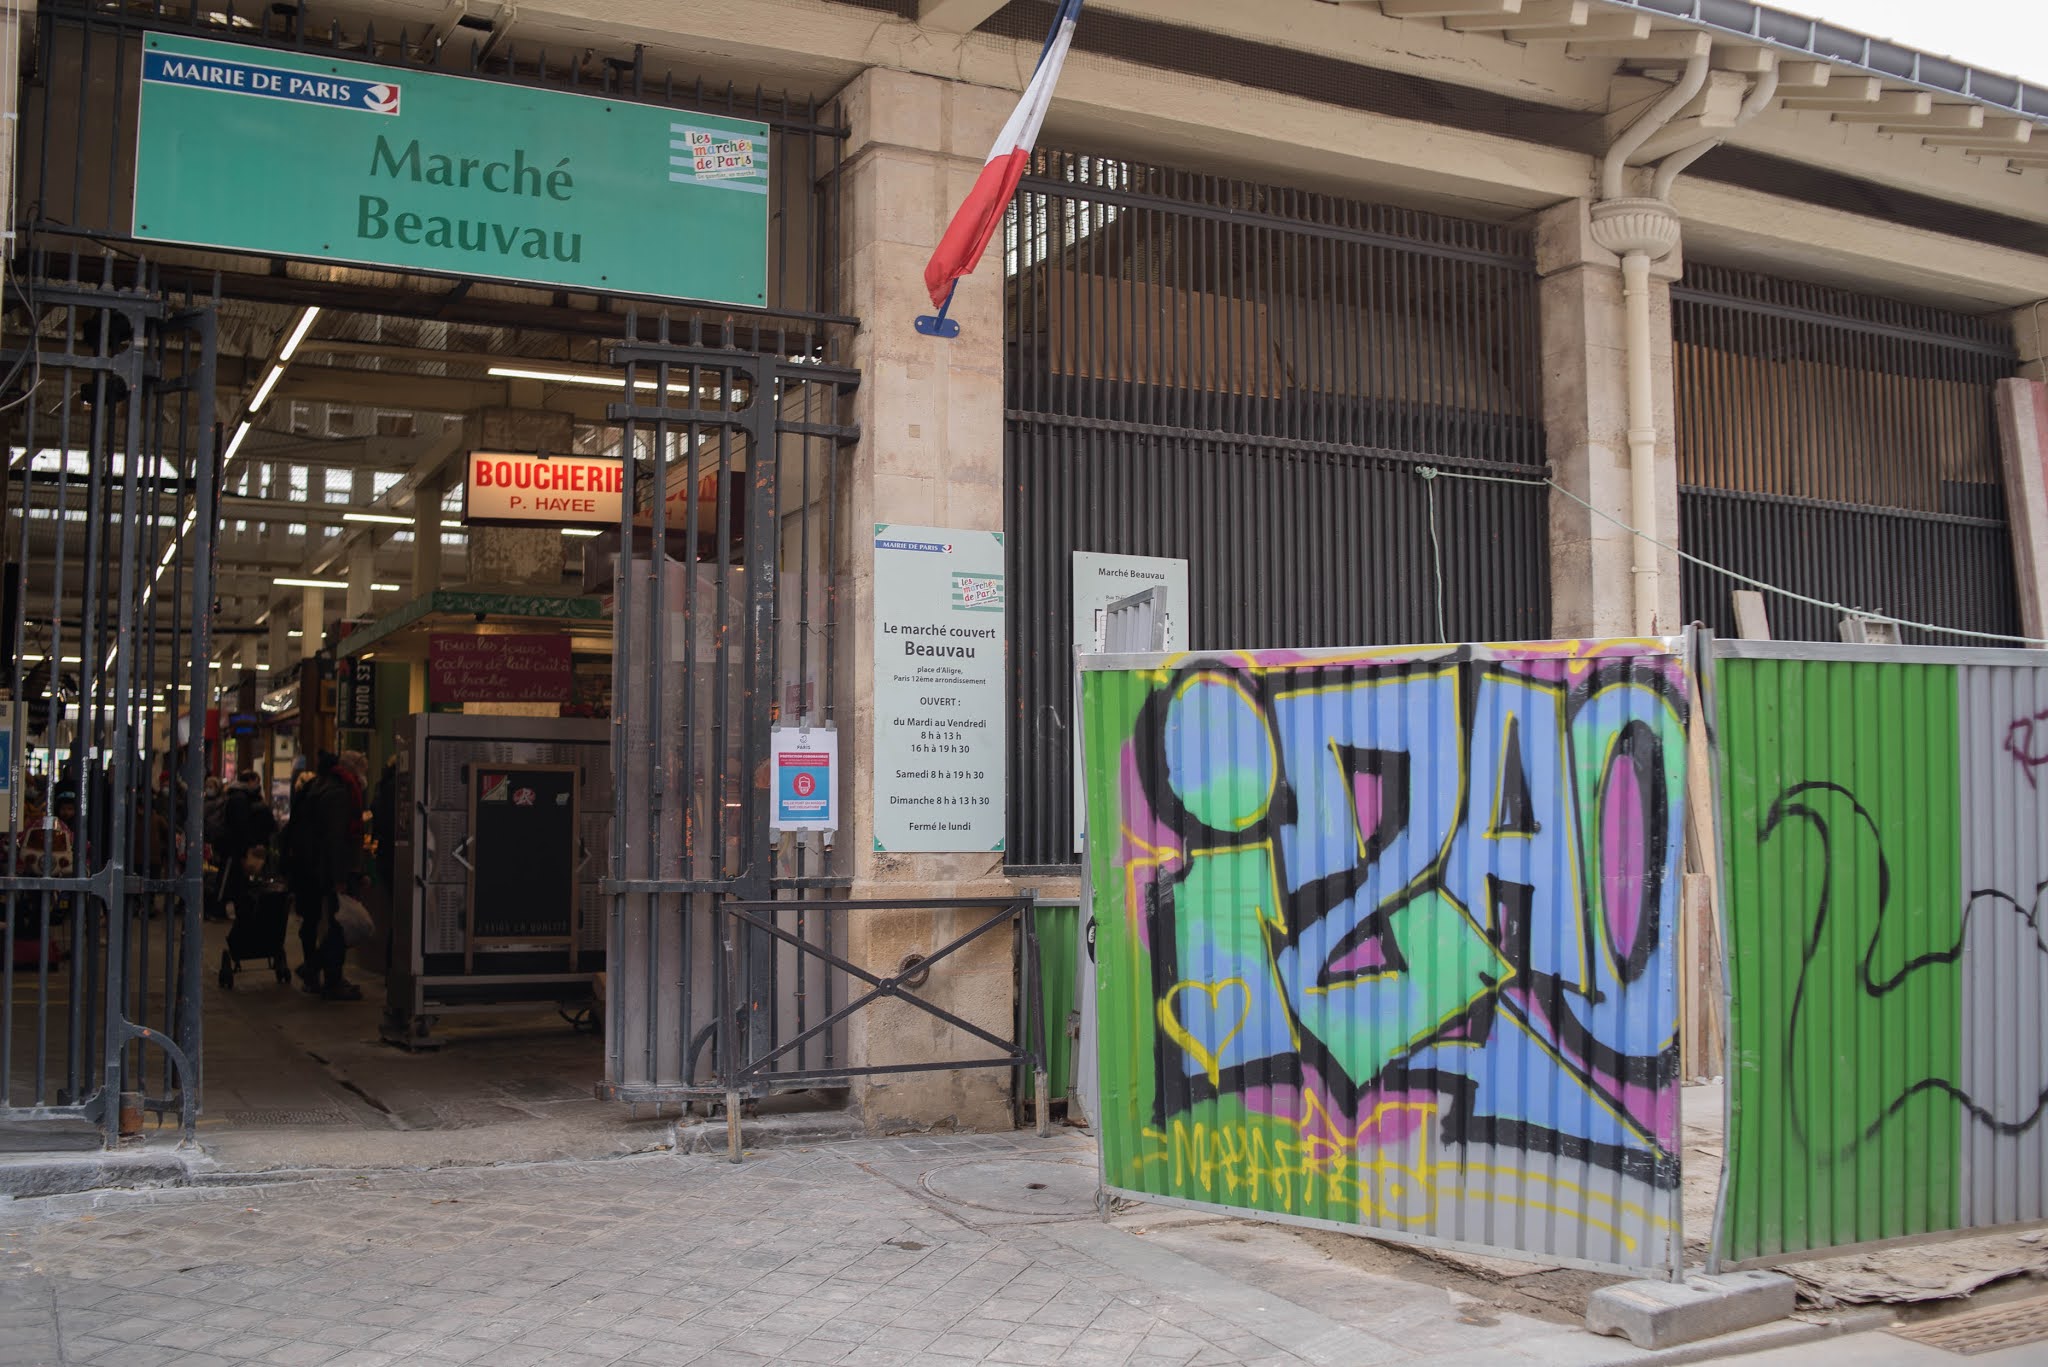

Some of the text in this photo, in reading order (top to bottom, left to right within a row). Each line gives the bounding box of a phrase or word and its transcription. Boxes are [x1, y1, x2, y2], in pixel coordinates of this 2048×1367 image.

[162, 59, 350, 102] MAIRIE DE PARIS
[691, 133, 710, 144] les
[694, 140, 752, 155] marchés
[371, 134, 574, 200] Marché
[696, 155, 751, 170] de Paris
[357, 196, 582, 263] Beauvau
[476, 460, 624, 493] BOUCHERIE
[510, 496, 595, 512] P. HAYEE
[1098, 568, 1165, 580] Marché Beauvau
[964, 594, 974, 602] de
[884, 622, 996, 639] Le marché couvert
[905, 640, 975, 658] Beauvau
[917, 666, 963, 675] place d'Aligre,
[912, 675, 934, 683] 12ème
[935, 676, 986, 685] arrondissement
[355, 658, 371, 726] ES QUAIS
[920, 697, 956, 706] OUVERT
[893, 718, 905, 726] du
[907, 718, 933, 727] Mardi
[947, 719, 987, 728] Vendredi
[920, 731, 962, 740] 8 h à 13 h
[911, 744, 970, 753] 16 h à 19 h 30
[896, 770, 984, 779] Samedi 8 h à 19 h 30
[890, 796, 990, 805] Dimanche 8 h à 13 h 30
[909, 822, 971, 831] Fermé le lundi
